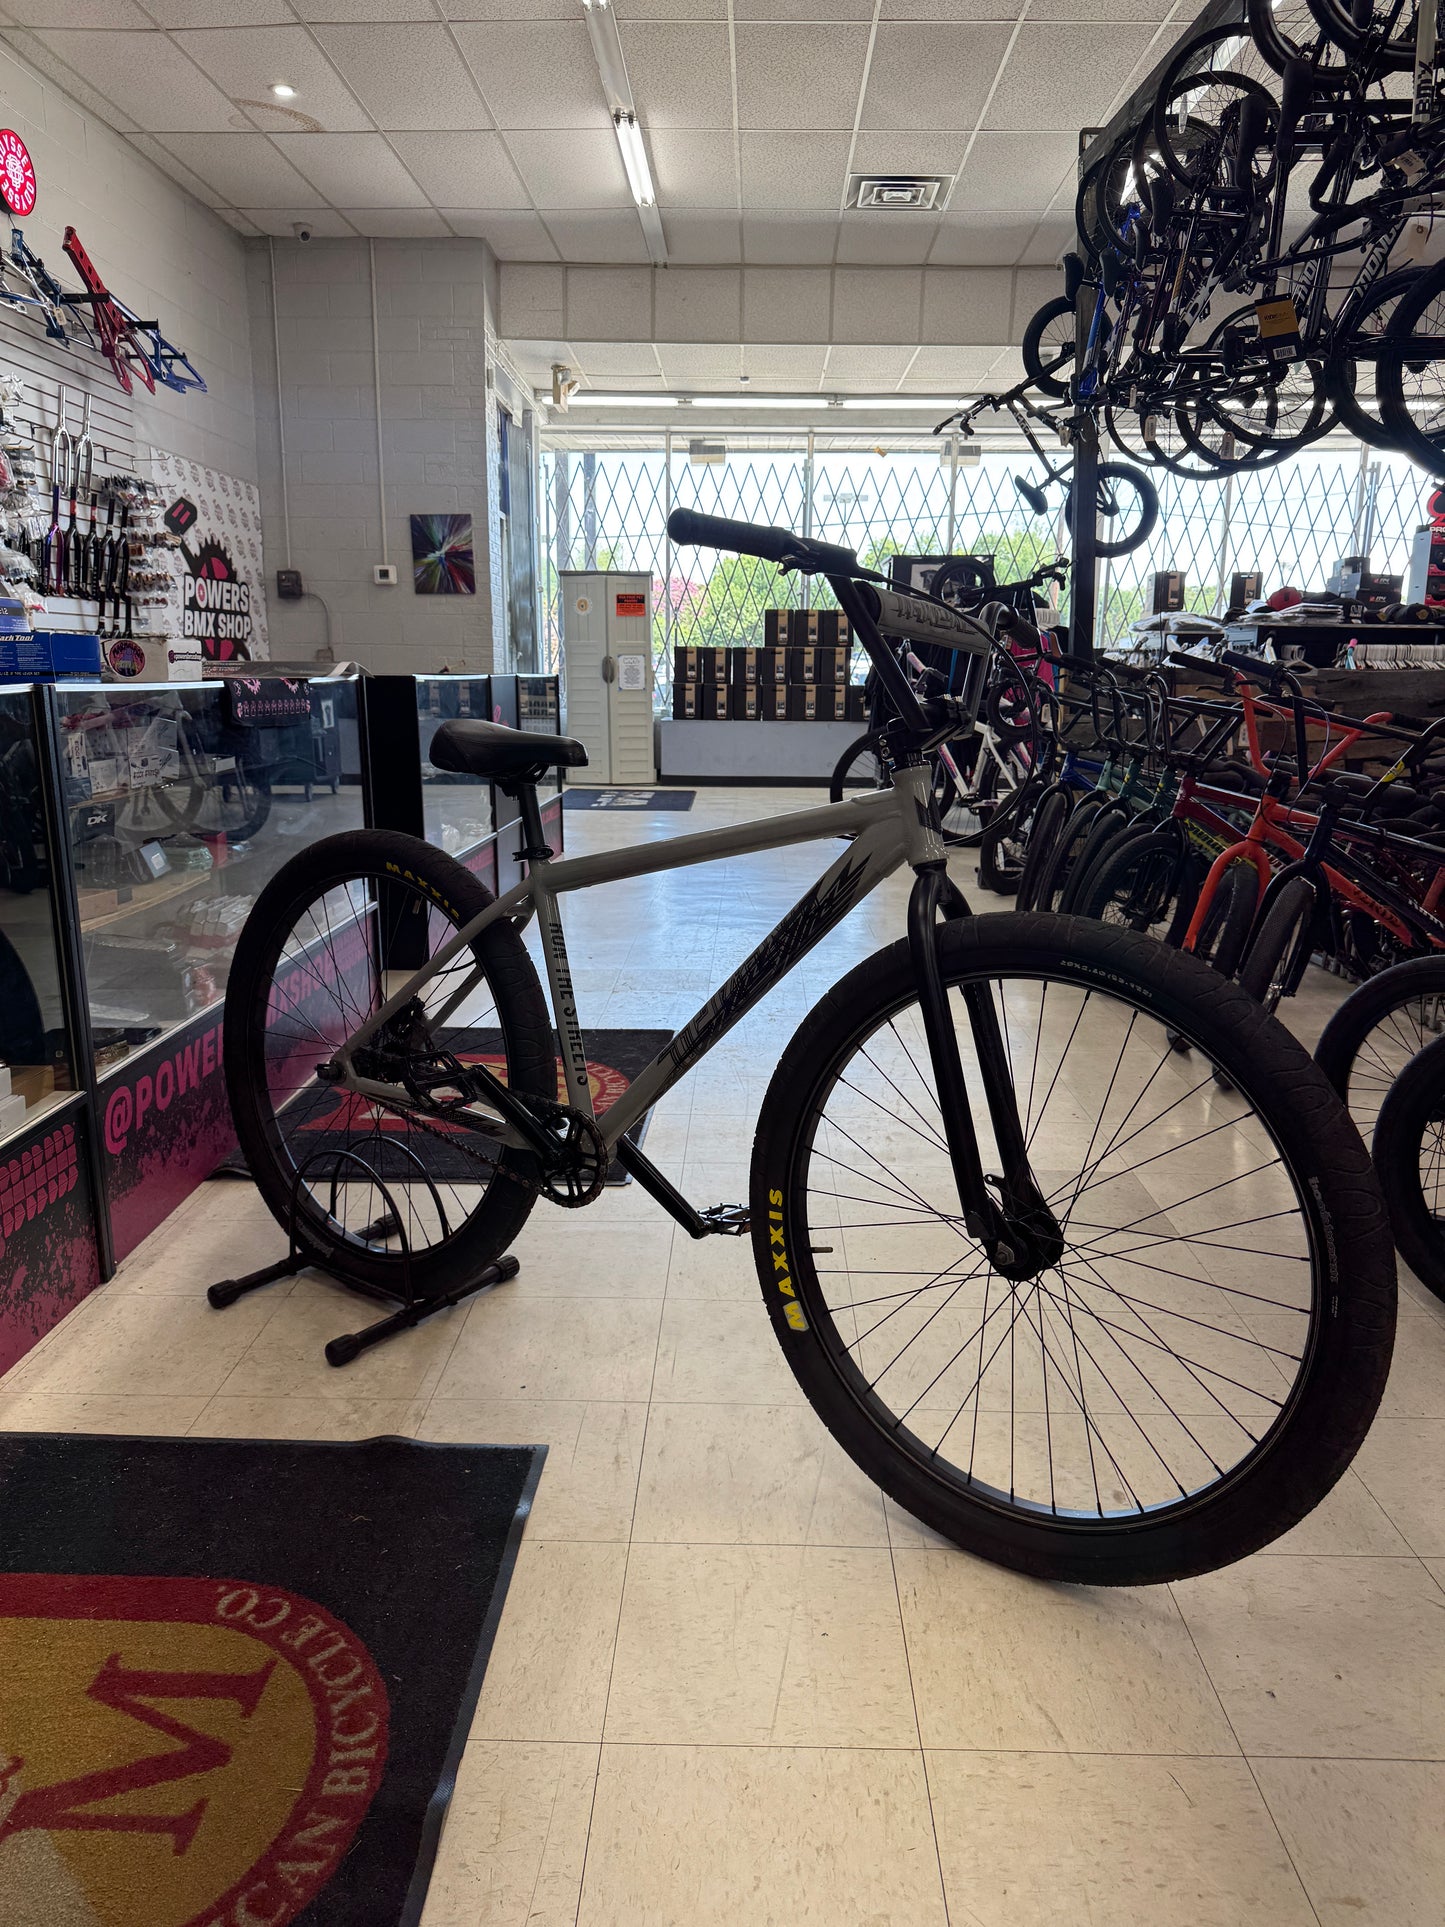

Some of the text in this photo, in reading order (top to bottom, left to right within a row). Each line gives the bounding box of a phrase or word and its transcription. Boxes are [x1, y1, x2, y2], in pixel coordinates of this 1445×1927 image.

[184, 575, 250, 614] POWERS
[184, 609, 252, 640] BMX SHOP
[87, 814, 108, 826] DK
[385, 860, 461, 921] MAXXIS
[768, 1188, 810, 1332] MAXXIS
[281, 1613, 380, 1797] BICYCLE
